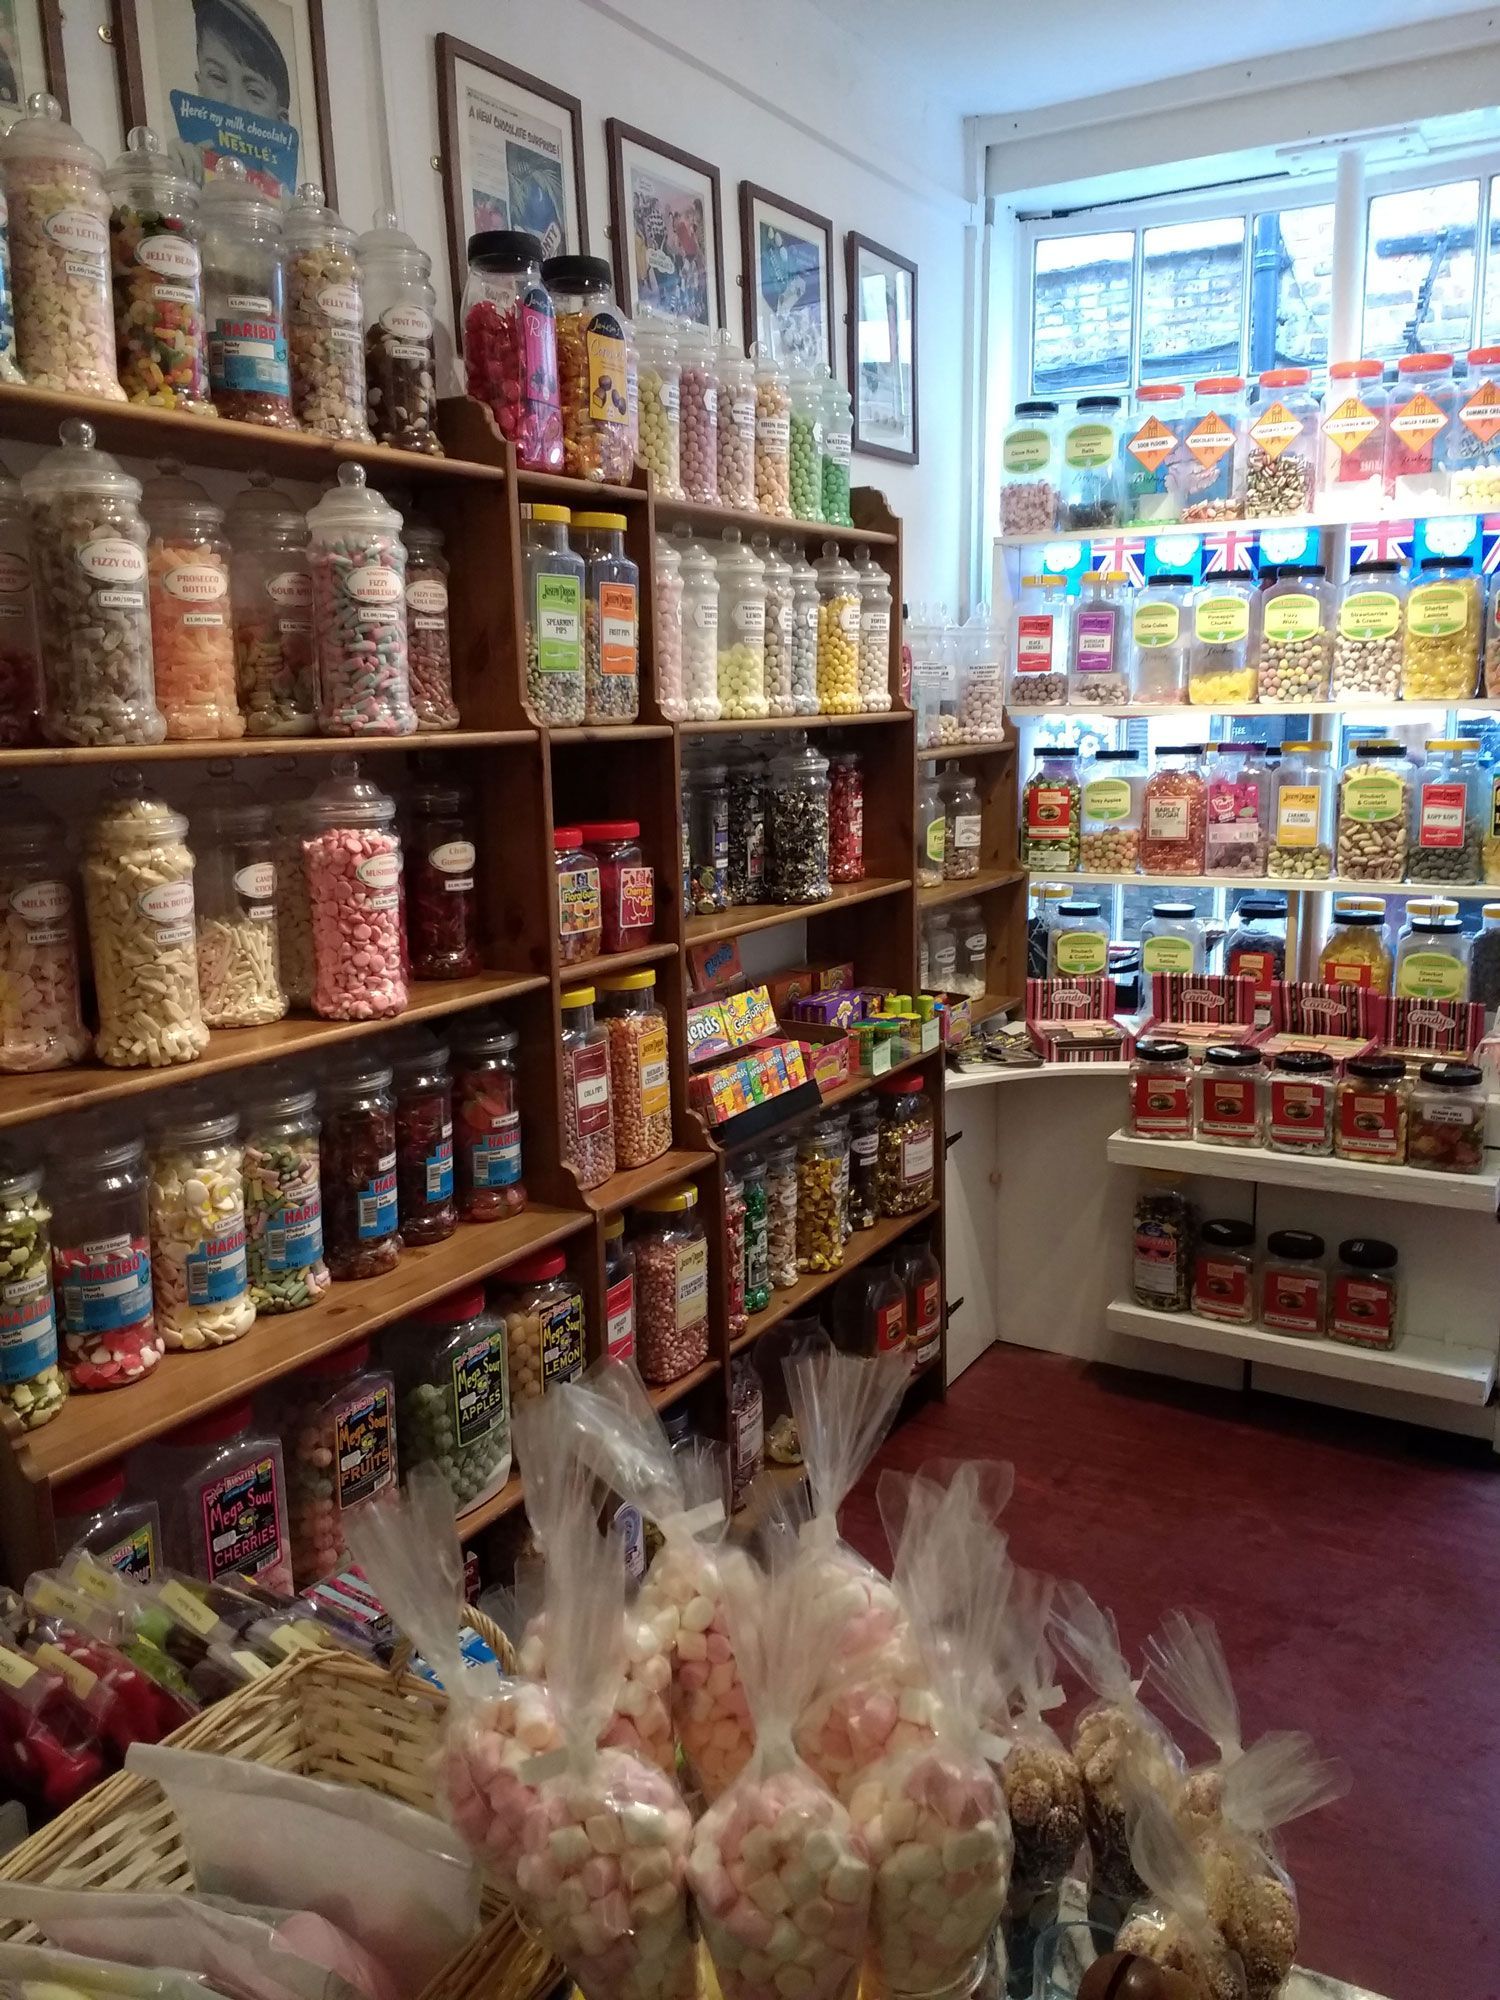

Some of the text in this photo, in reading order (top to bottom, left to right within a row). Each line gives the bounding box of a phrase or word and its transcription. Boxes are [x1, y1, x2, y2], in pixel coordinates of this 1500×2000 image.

[181, 98, 208, 120] Here's
[209, 112, 224, 127] my
[225, 116, 245, 132] milk
[468, 105, 475, 119] A
[476, 109, 492, 124] NEW
[146, 252, 173, 262] JELLY
[321, 299, 344, 309] JELLY
[222, 322, 277, 341] HARIBO
[91, 558, 142, 569] FIZZY COLA
[176, 574, 220, 584] PROSECCO
[182, 584, 217, 594] BOTTLES
[546, 617, 575, 627] SPEARMINT
[556, 626, 568, 635] PIPS
[609, 628, 631, 637] FRUIT PIPS
[564, 891, 583, 901] Floral
[625, 886, 643, 896] Cherry
[21, 898, 48, 909] MILK
[149, 901, 170, 910] MILK
[1053, 992, 1085, 1007] Candy
[1182, 992, 1217, 1007] Candy
[1302, 998, 1339, 1013] Candy
[1409, 1012, 1447, 1029] Candy
[584, 1085, 603, 1098] COLA PIPS
[79, 1255, 140, 1281] HARIBO
[544, 1315, 581, 1347] Mega Sour
[545, 1346, 580, 1375] LEMON
[458, 1357, 500, 1392] Mega Sour
[462, 1388, 501, 1423] APPLES
[340, 1411, 388, 1452] Mega Sour
[341, 1446, 389, 1486] FRUITS
[210, 1487, 274, 1532] Mega Sour
[214, 1524, 276, 1567] CHERRIES
[124, 1565, 151, 1584] Sour
